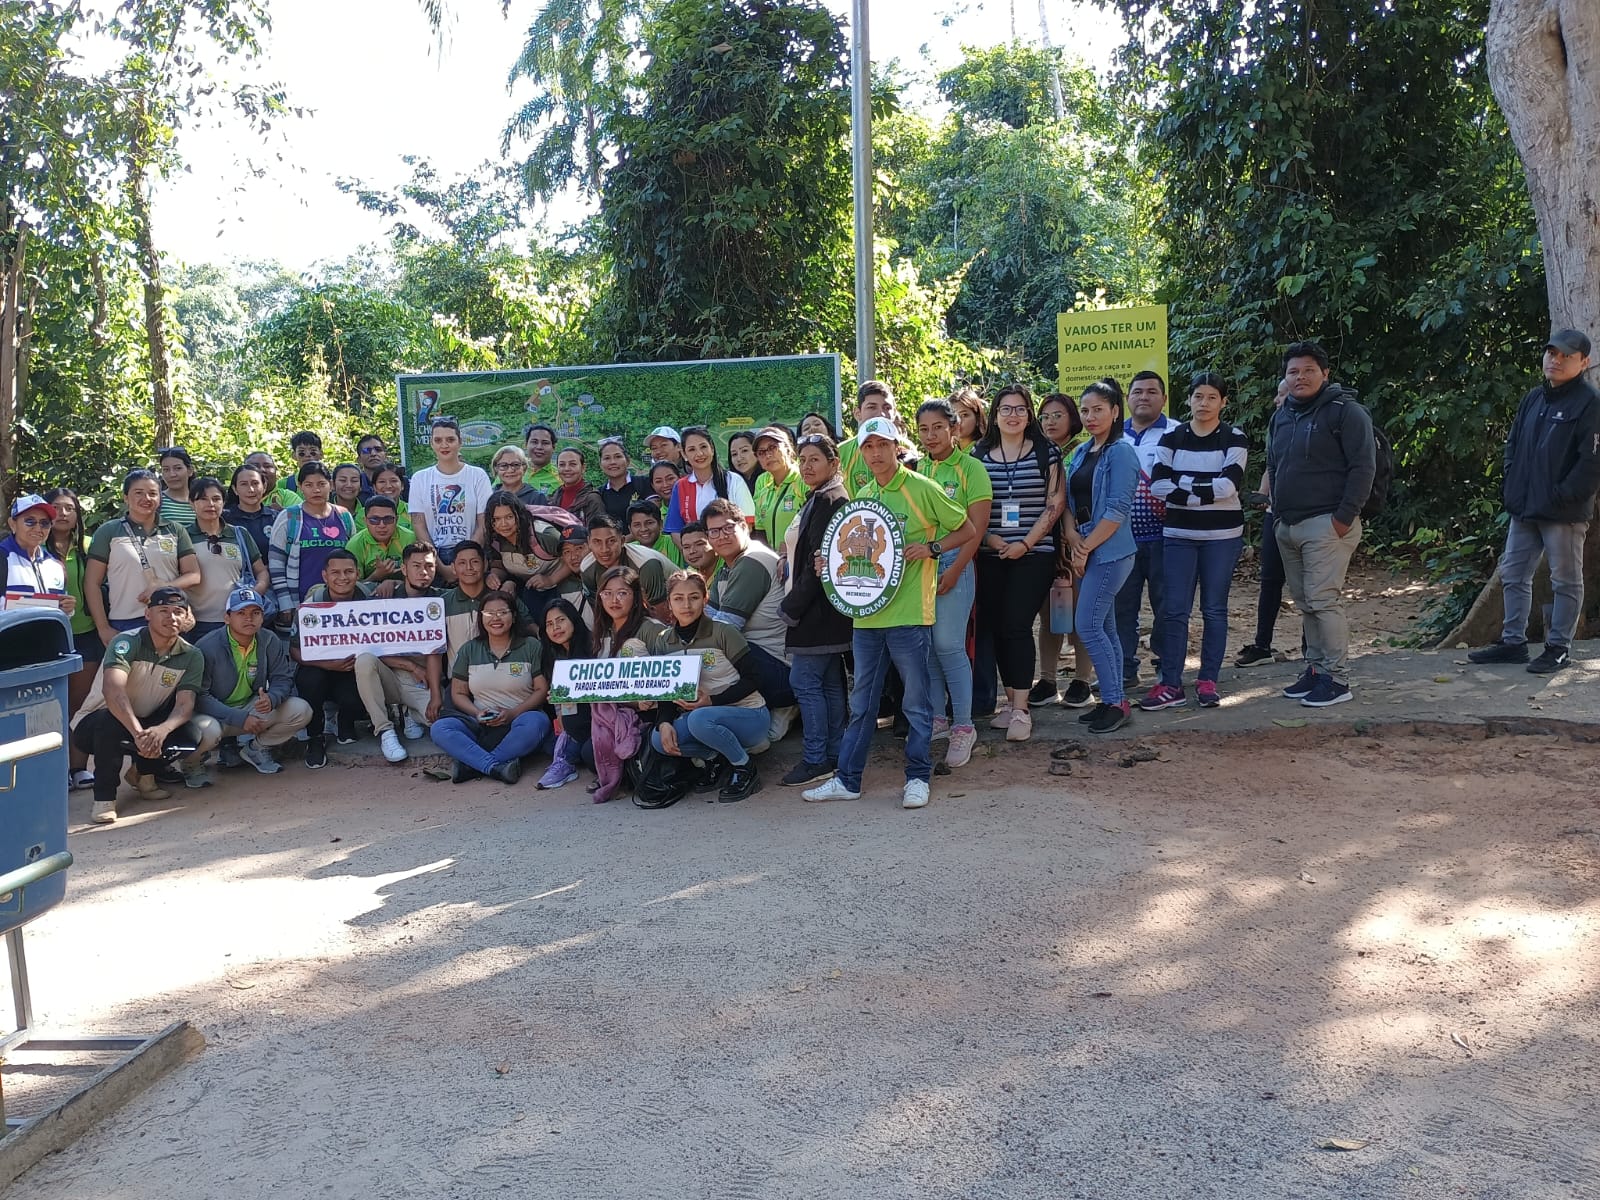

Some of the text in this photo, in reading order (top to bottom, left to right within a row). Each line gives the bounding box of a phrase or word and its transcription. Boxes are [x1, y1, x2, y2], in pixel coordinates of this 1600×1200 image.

[1064, 321, 1156, 336] VAMOS TER UM
[1065, 338, 1156, 353] PAPO ANIMAL?
[1072, 364, 1097, 372] tráfico,
[311, 528, 319, 537] I
[821, 500, 903, 587] UNERSIDAD AMAZÓNICA DE PANDO
[830, 593, 853, 615] COBIJA
[860, 596, 889, 616] BOLIVIA
[320, 609, 424, 628] PRÁCTICAS
[304, 629, 443, 647] INTERNACIONALES
[569, 660, 681, 680] CHICO MENDES
[575, 682, 597, 692] PARQUE
[598, 680, 629, 691] AMBIENTAL
[634, 680, 644, 689] RIO
[645, 679, 670, 689] BRANCO
